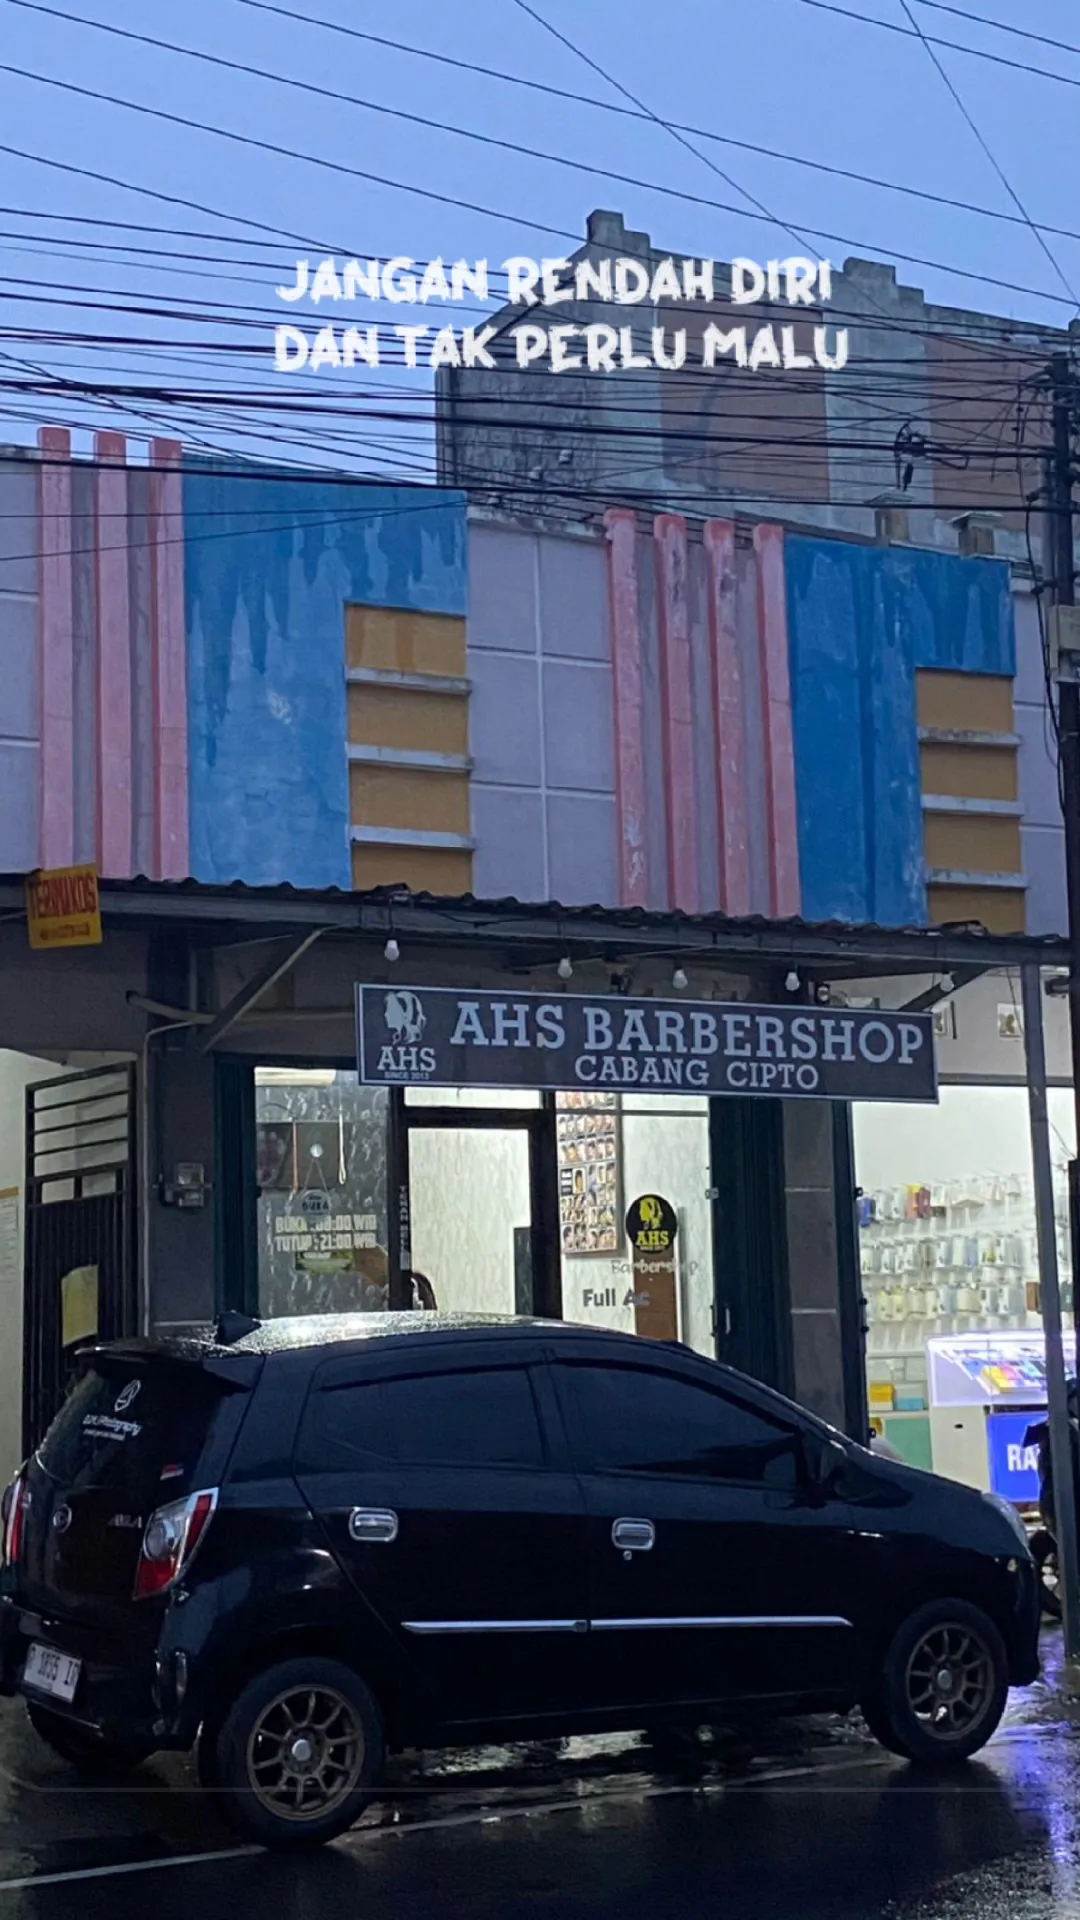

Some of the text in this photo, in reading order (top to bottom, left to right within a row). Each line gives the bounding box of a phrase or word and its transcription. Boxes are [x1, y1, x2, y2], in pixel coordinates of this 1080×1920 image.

[450, 1001, 924, 1065] AHS BARBERSHOP
[377, 1045, 437, 1072] AHS
[574, 1055, 819, 1090] CABANG CIPTO
[637, 1230, 669, 1247] AHS
[611, 1258, 699, 1276] Barbersp
[583, 1287, 617, 1308] Full
[1007, 1443, 1041, 1472] RA
